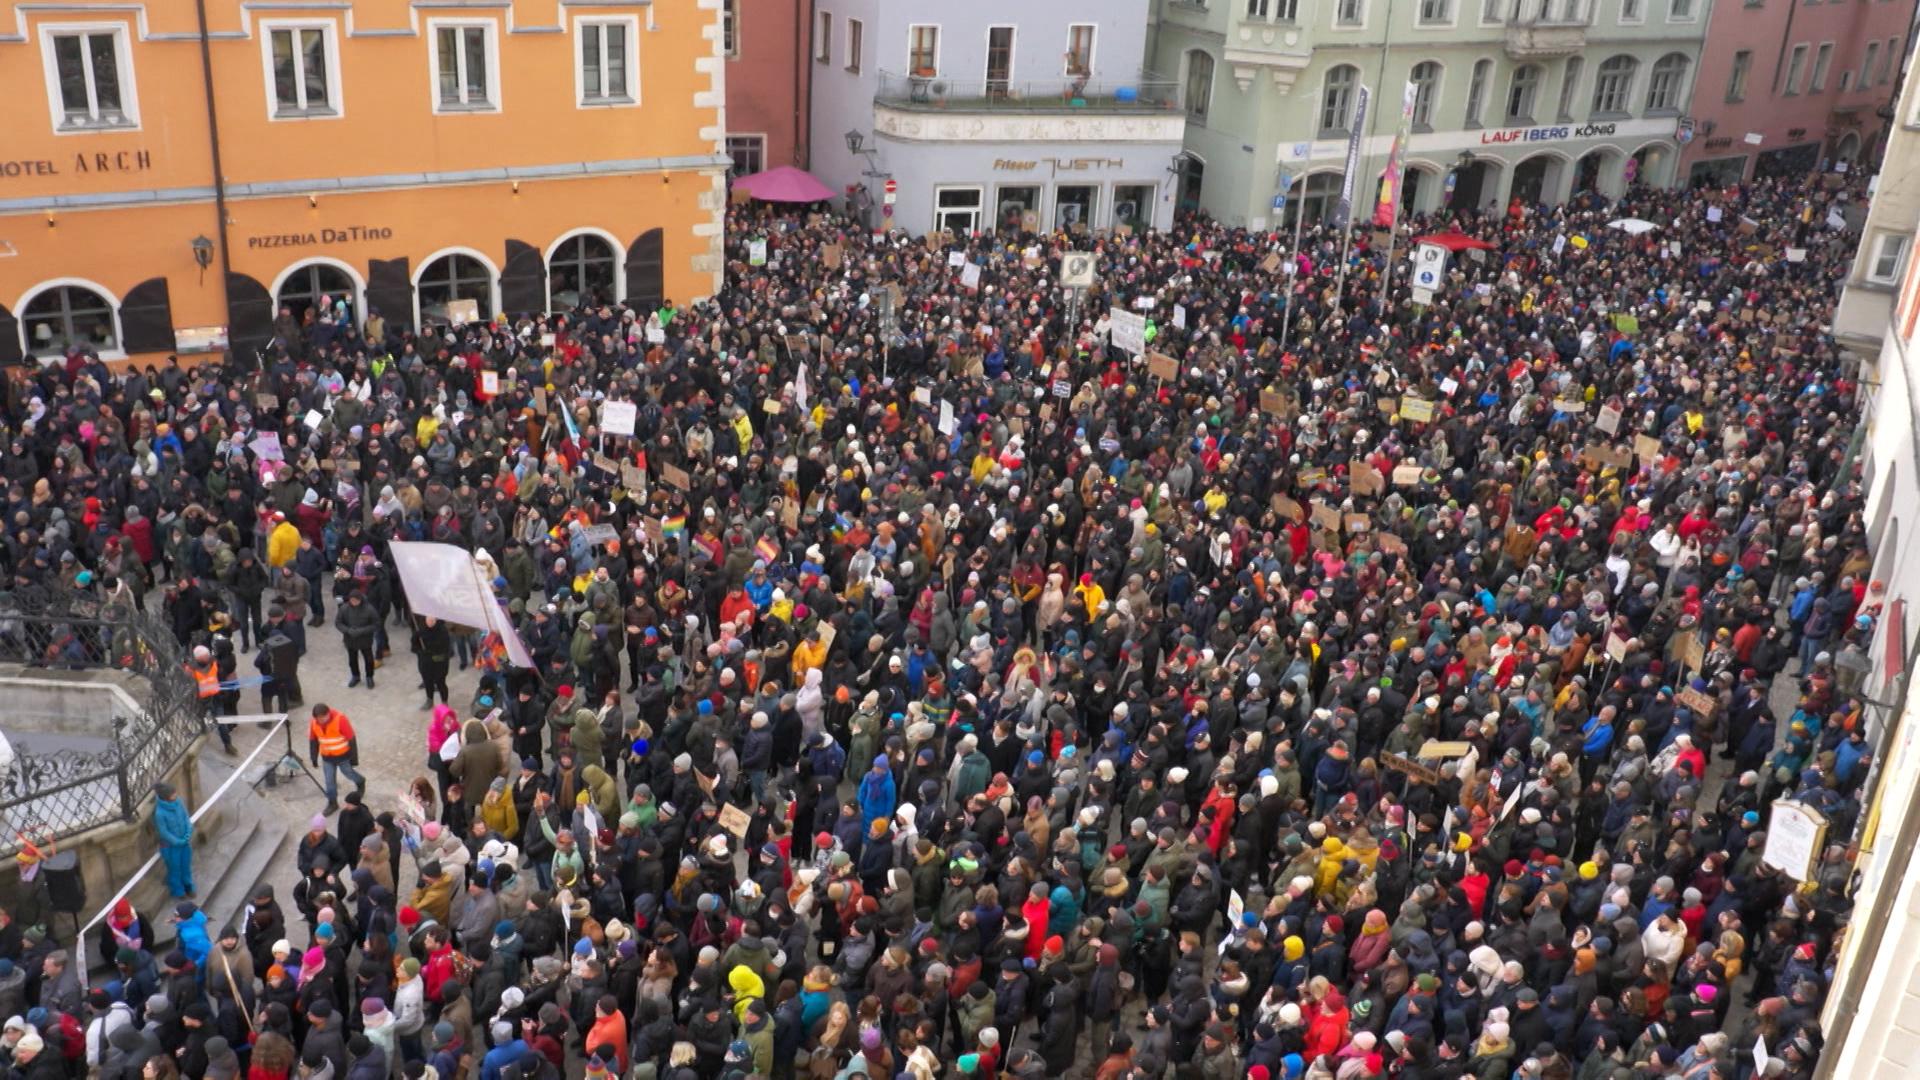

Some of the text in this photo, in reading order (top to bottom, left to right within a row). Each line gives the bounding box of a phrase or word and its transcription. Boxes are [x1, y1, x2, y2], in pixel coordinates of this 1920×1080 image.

[1574, 123, 1616, 137] KÖNIG
[75, 149, 151, 173] ARCH
[248, 233, 317, 248] PIZZERIA
